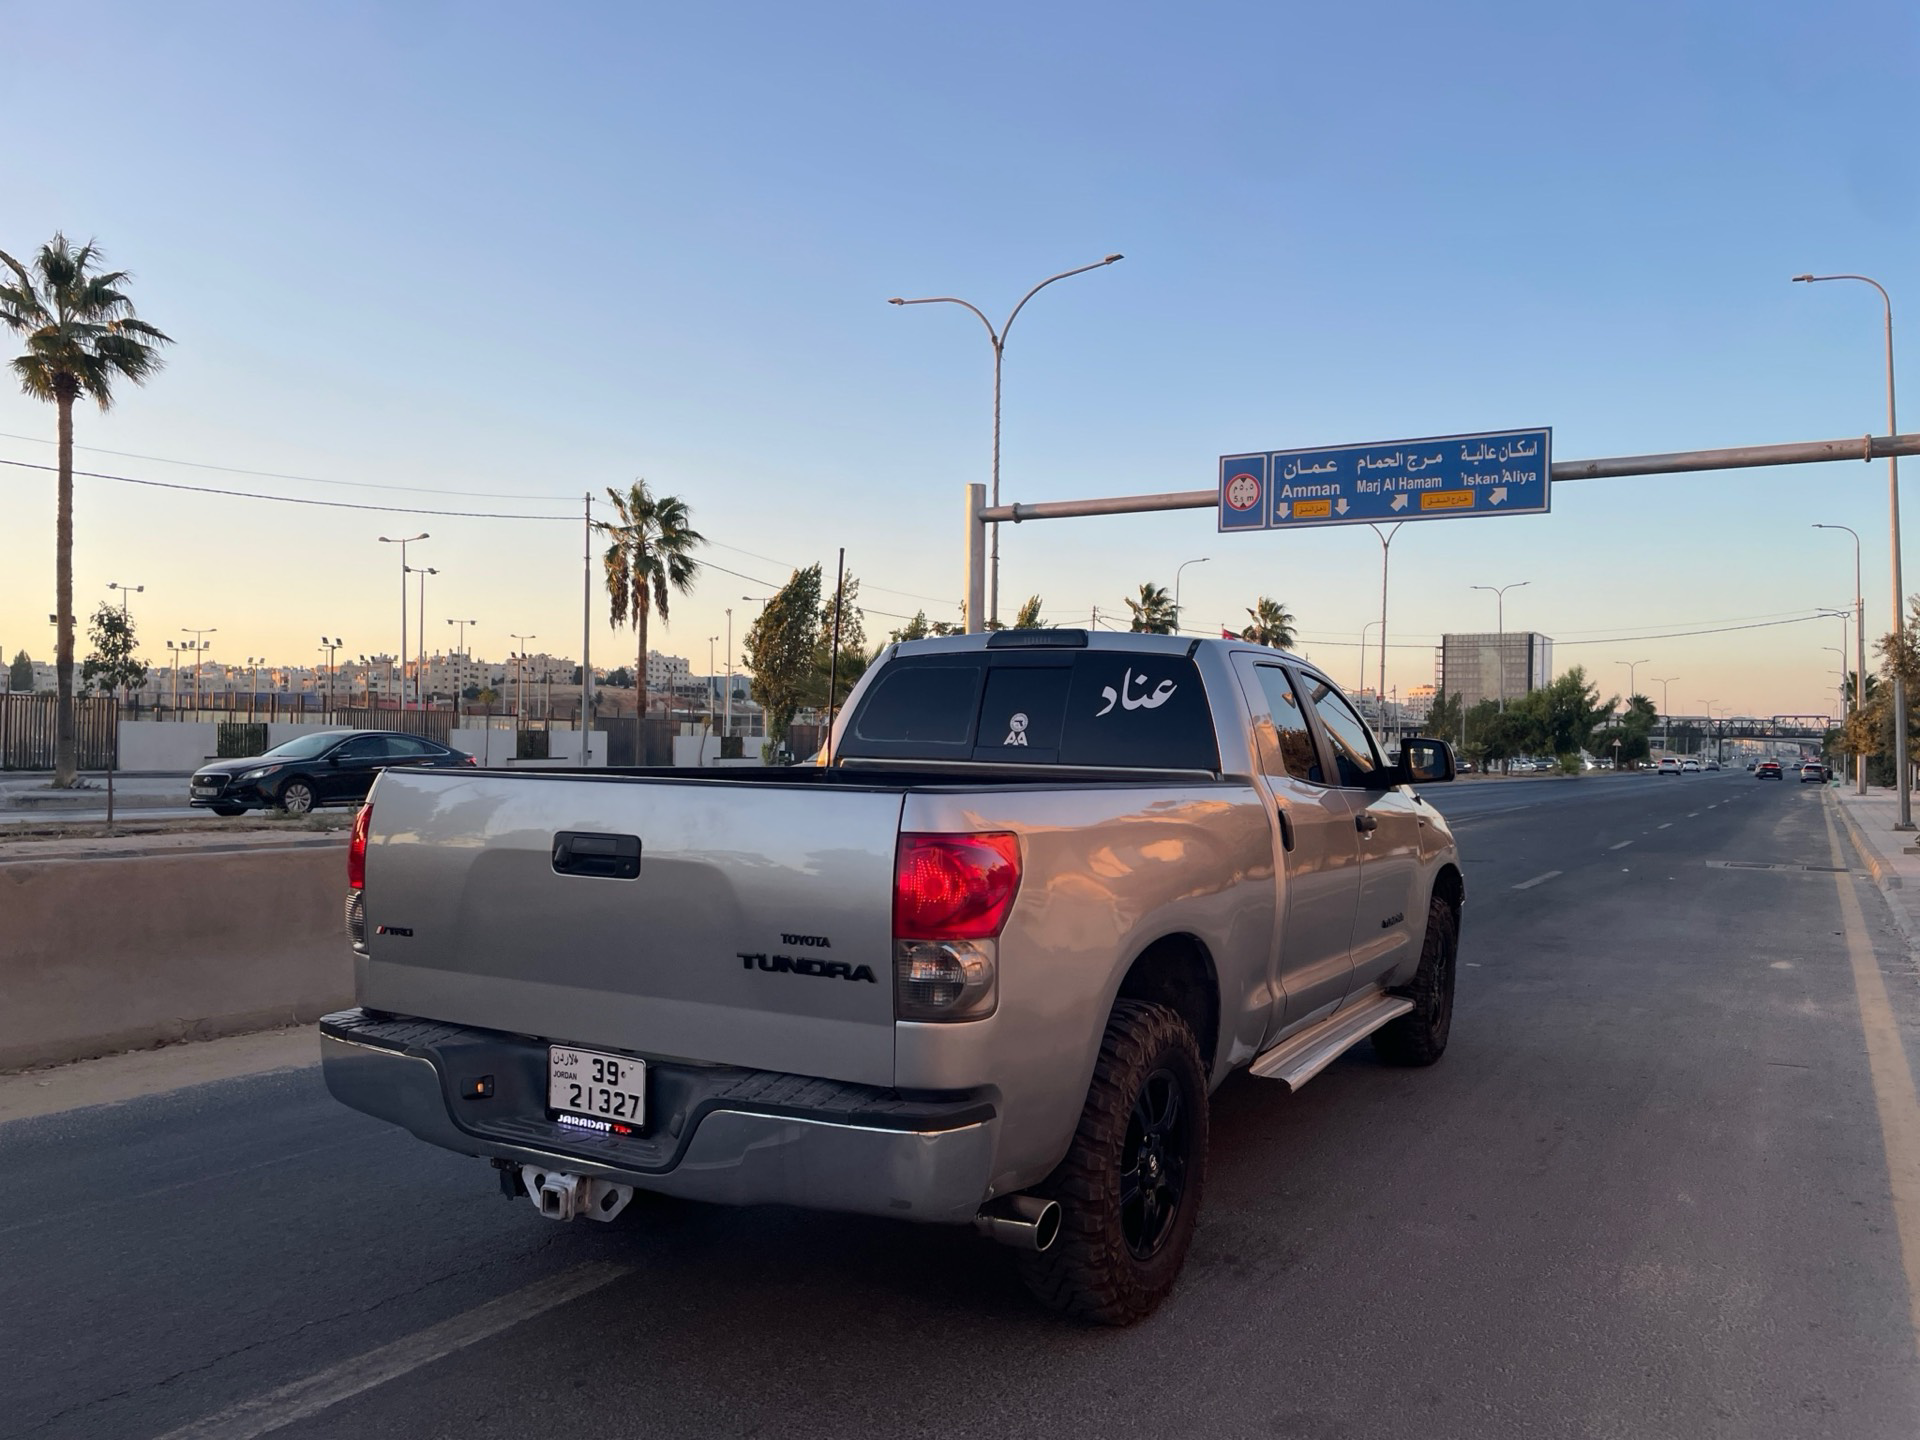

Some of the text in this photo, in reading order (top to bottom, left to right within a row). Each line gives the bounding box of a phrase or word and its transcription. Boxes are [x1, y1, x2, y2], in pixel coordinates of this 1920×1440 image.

[1357, 451, 1443, 475] مرج الحمام
[1461, 440, 1538, 466] اسكان عالية
[1283, 458, 1338, 480] عمان
[1281, 483, 1341, 499] Amman
[1356, 476, 1443, 495] Marj Al Hamam
[1095, 667, 1178, 718] عناد
[780, 933, 831, 948] TOYOTA
[736, 952, 878, 984] TUNDRA
[553, 1069, 578, 1081] JORDAN
[592, 1058, 619, 1086] 39
[569, 1083, 641, 1119] 21327
[557, 1114, 612, 1132] JARADAT
